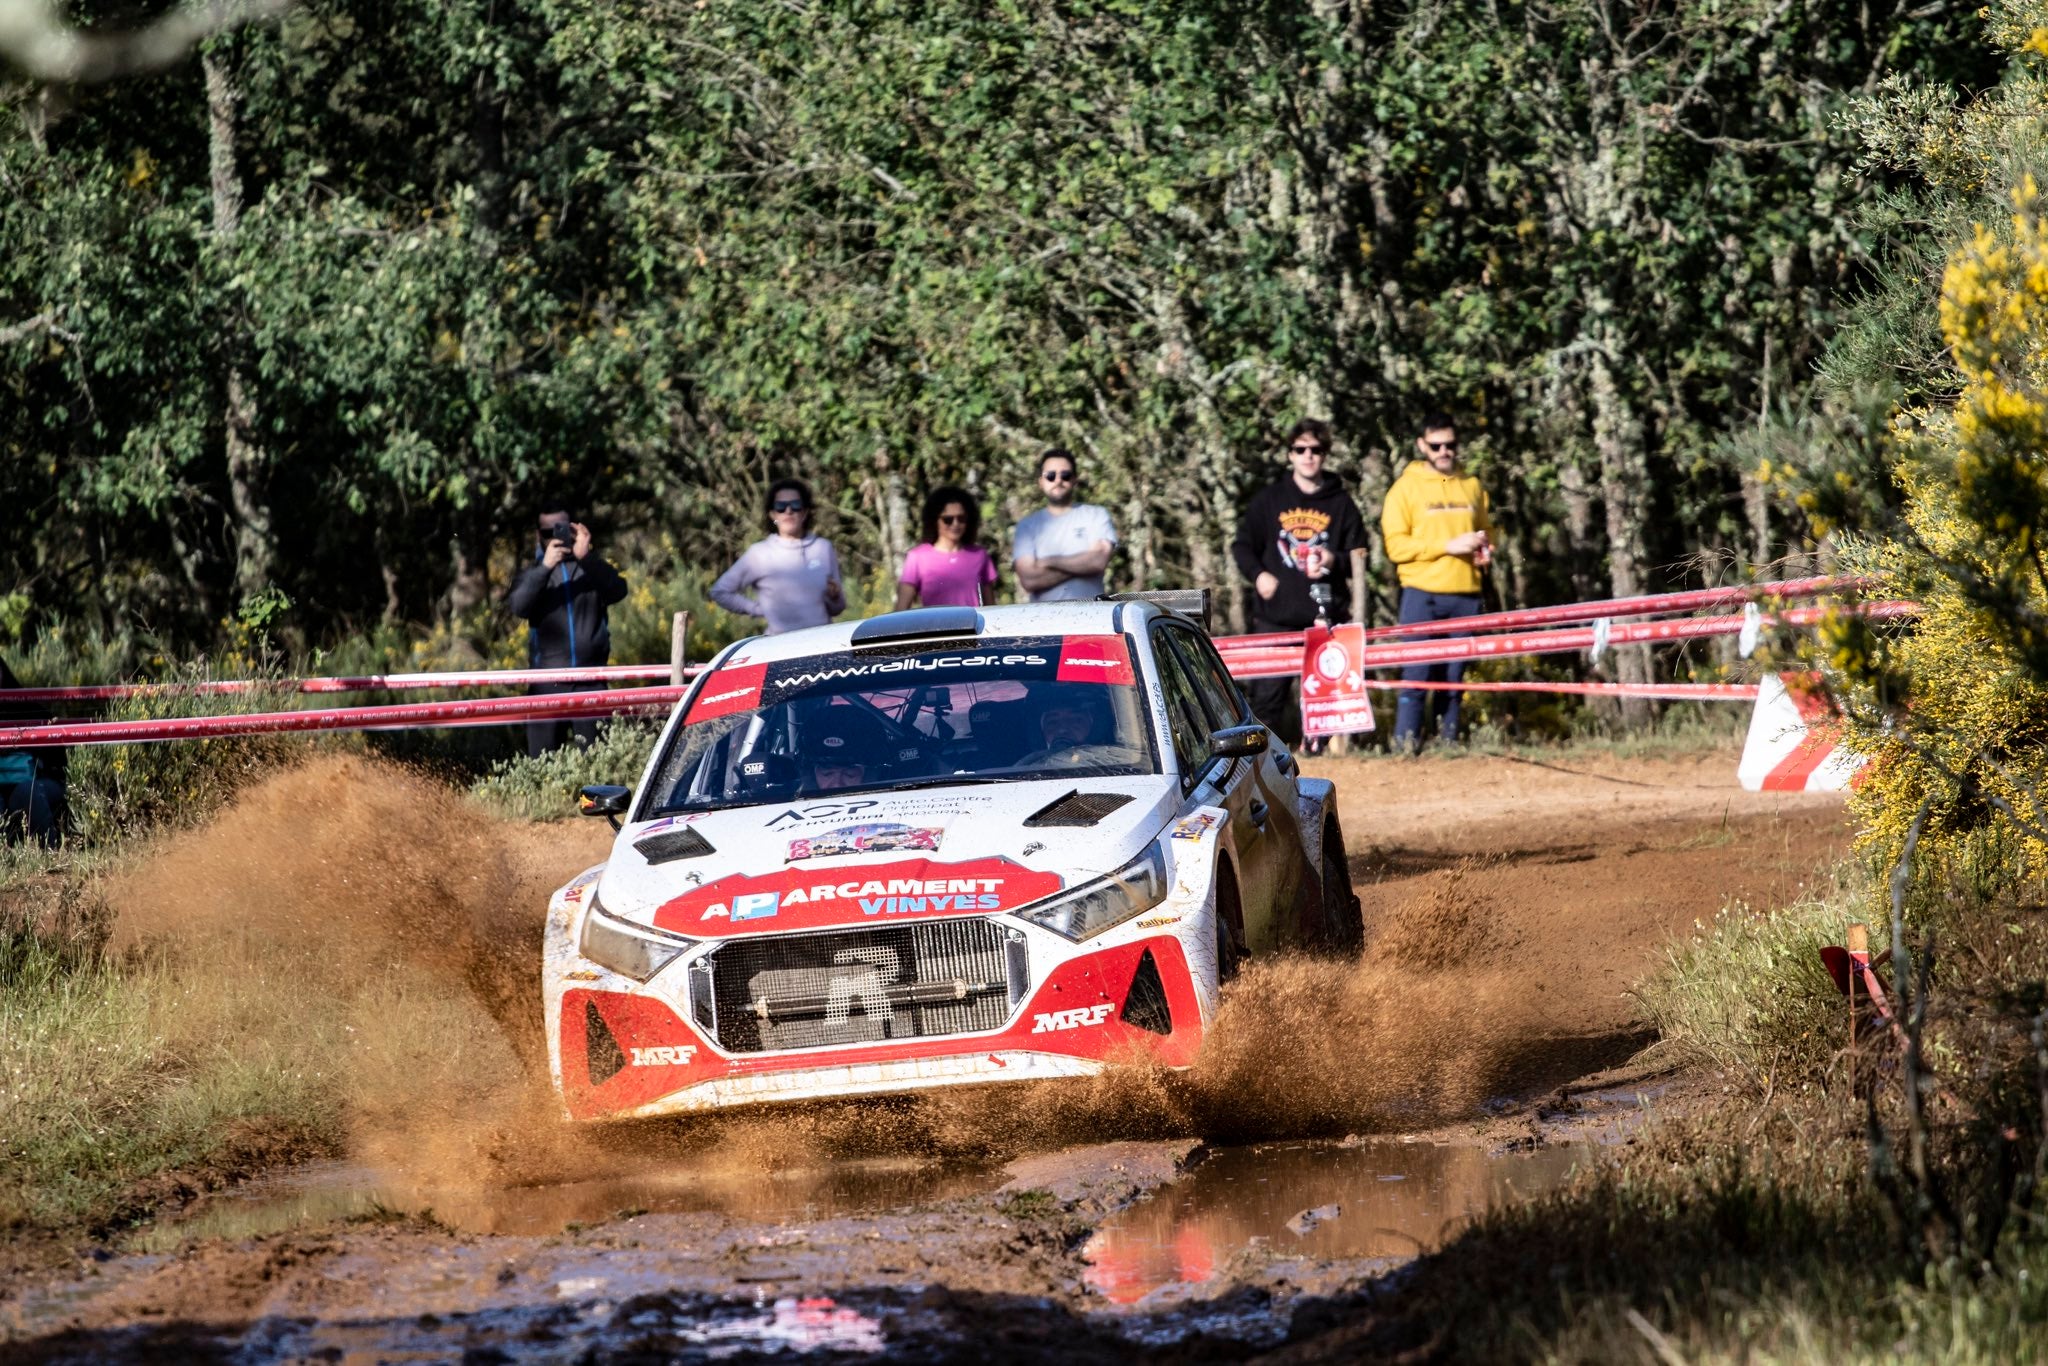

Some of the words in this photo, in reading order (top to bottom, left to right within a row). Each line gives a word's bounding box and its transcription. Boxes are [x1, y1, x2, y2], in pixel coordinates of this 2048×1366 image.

[775, 655, 1047, 688] www.rallycar.es
[1064, 658, 1121, 668] MRF
[899, 749, 919, 760] OMP
[744, 763, 764, 775] OMP
[858, 894, 1000, 915] VINYES
[1032, 1003, 1116, 1034] MRF
[630, 1045, 698, 1067] MRF
